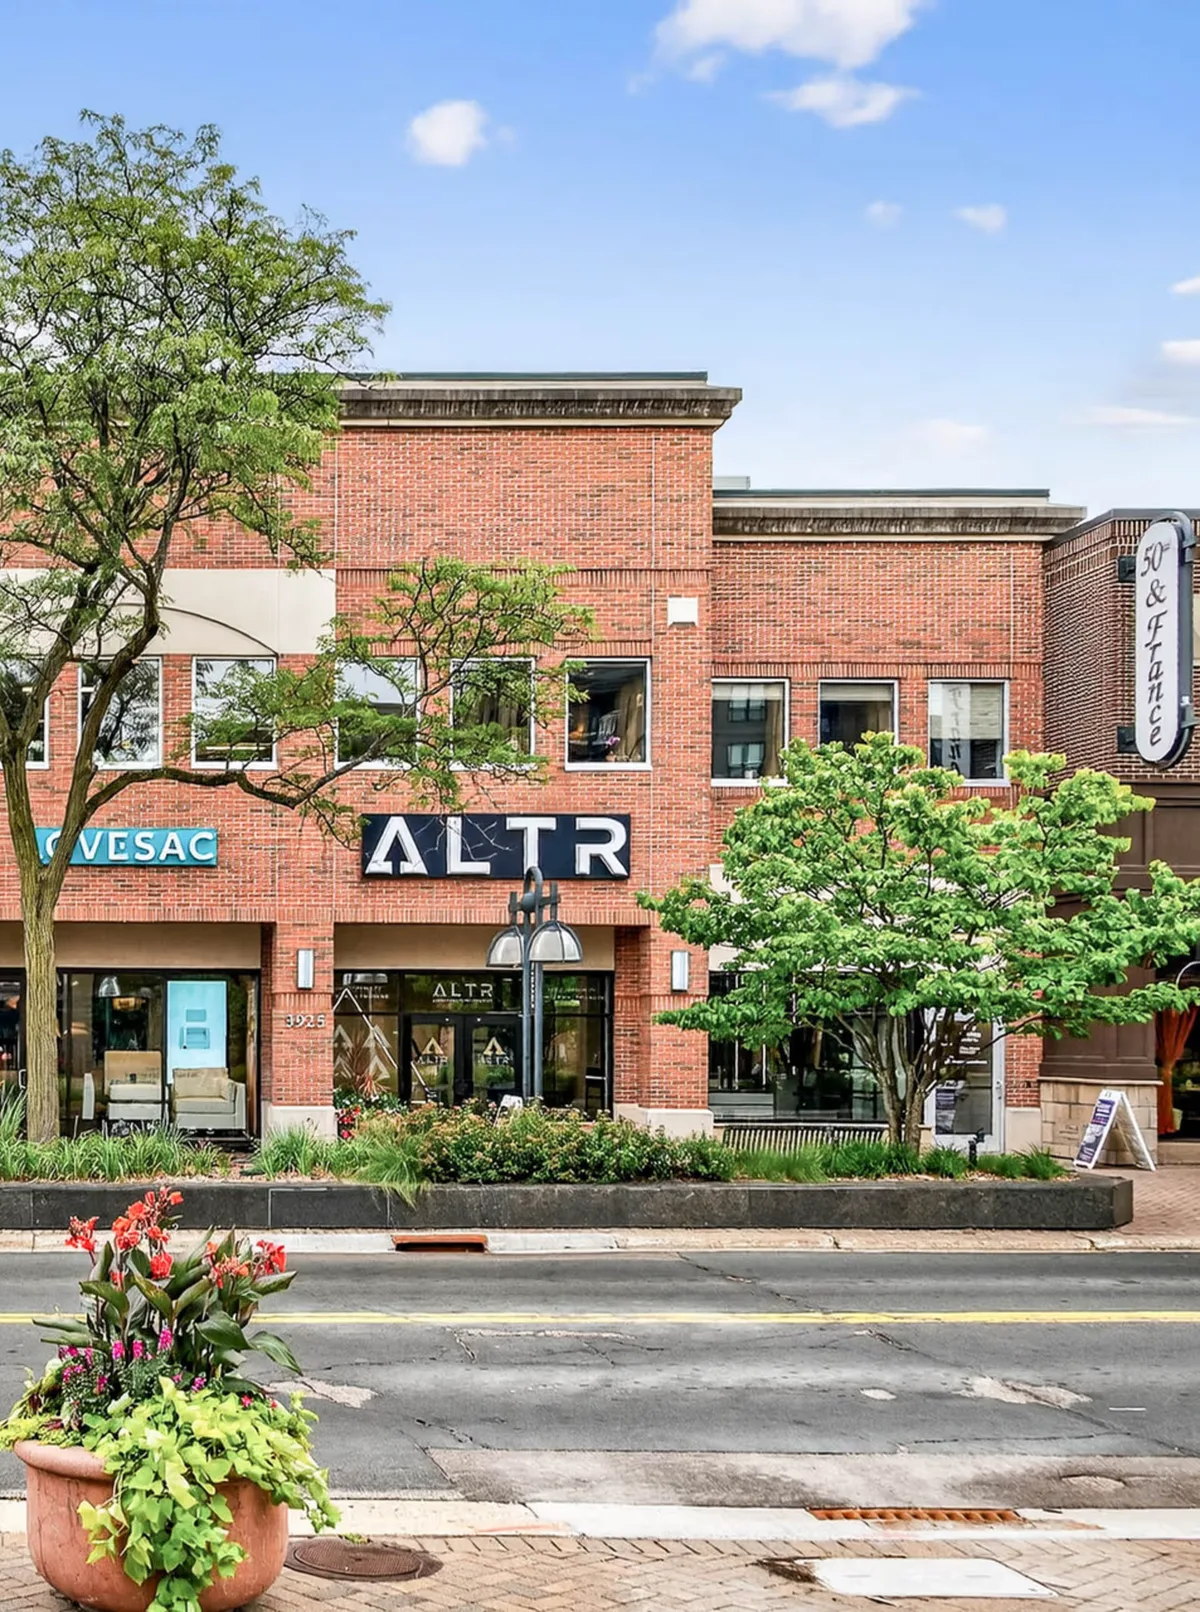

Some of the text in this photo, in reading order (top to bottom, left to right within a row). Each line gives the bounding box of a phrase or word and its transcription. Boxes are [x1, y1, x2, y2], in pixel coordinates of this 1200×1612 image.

[1146, 578, 1167, 608] &
[39, 830, 214, 861] VESAC
[364, 815, 628, 876] ALTR
[432, 983, 493, 998] ALTR
